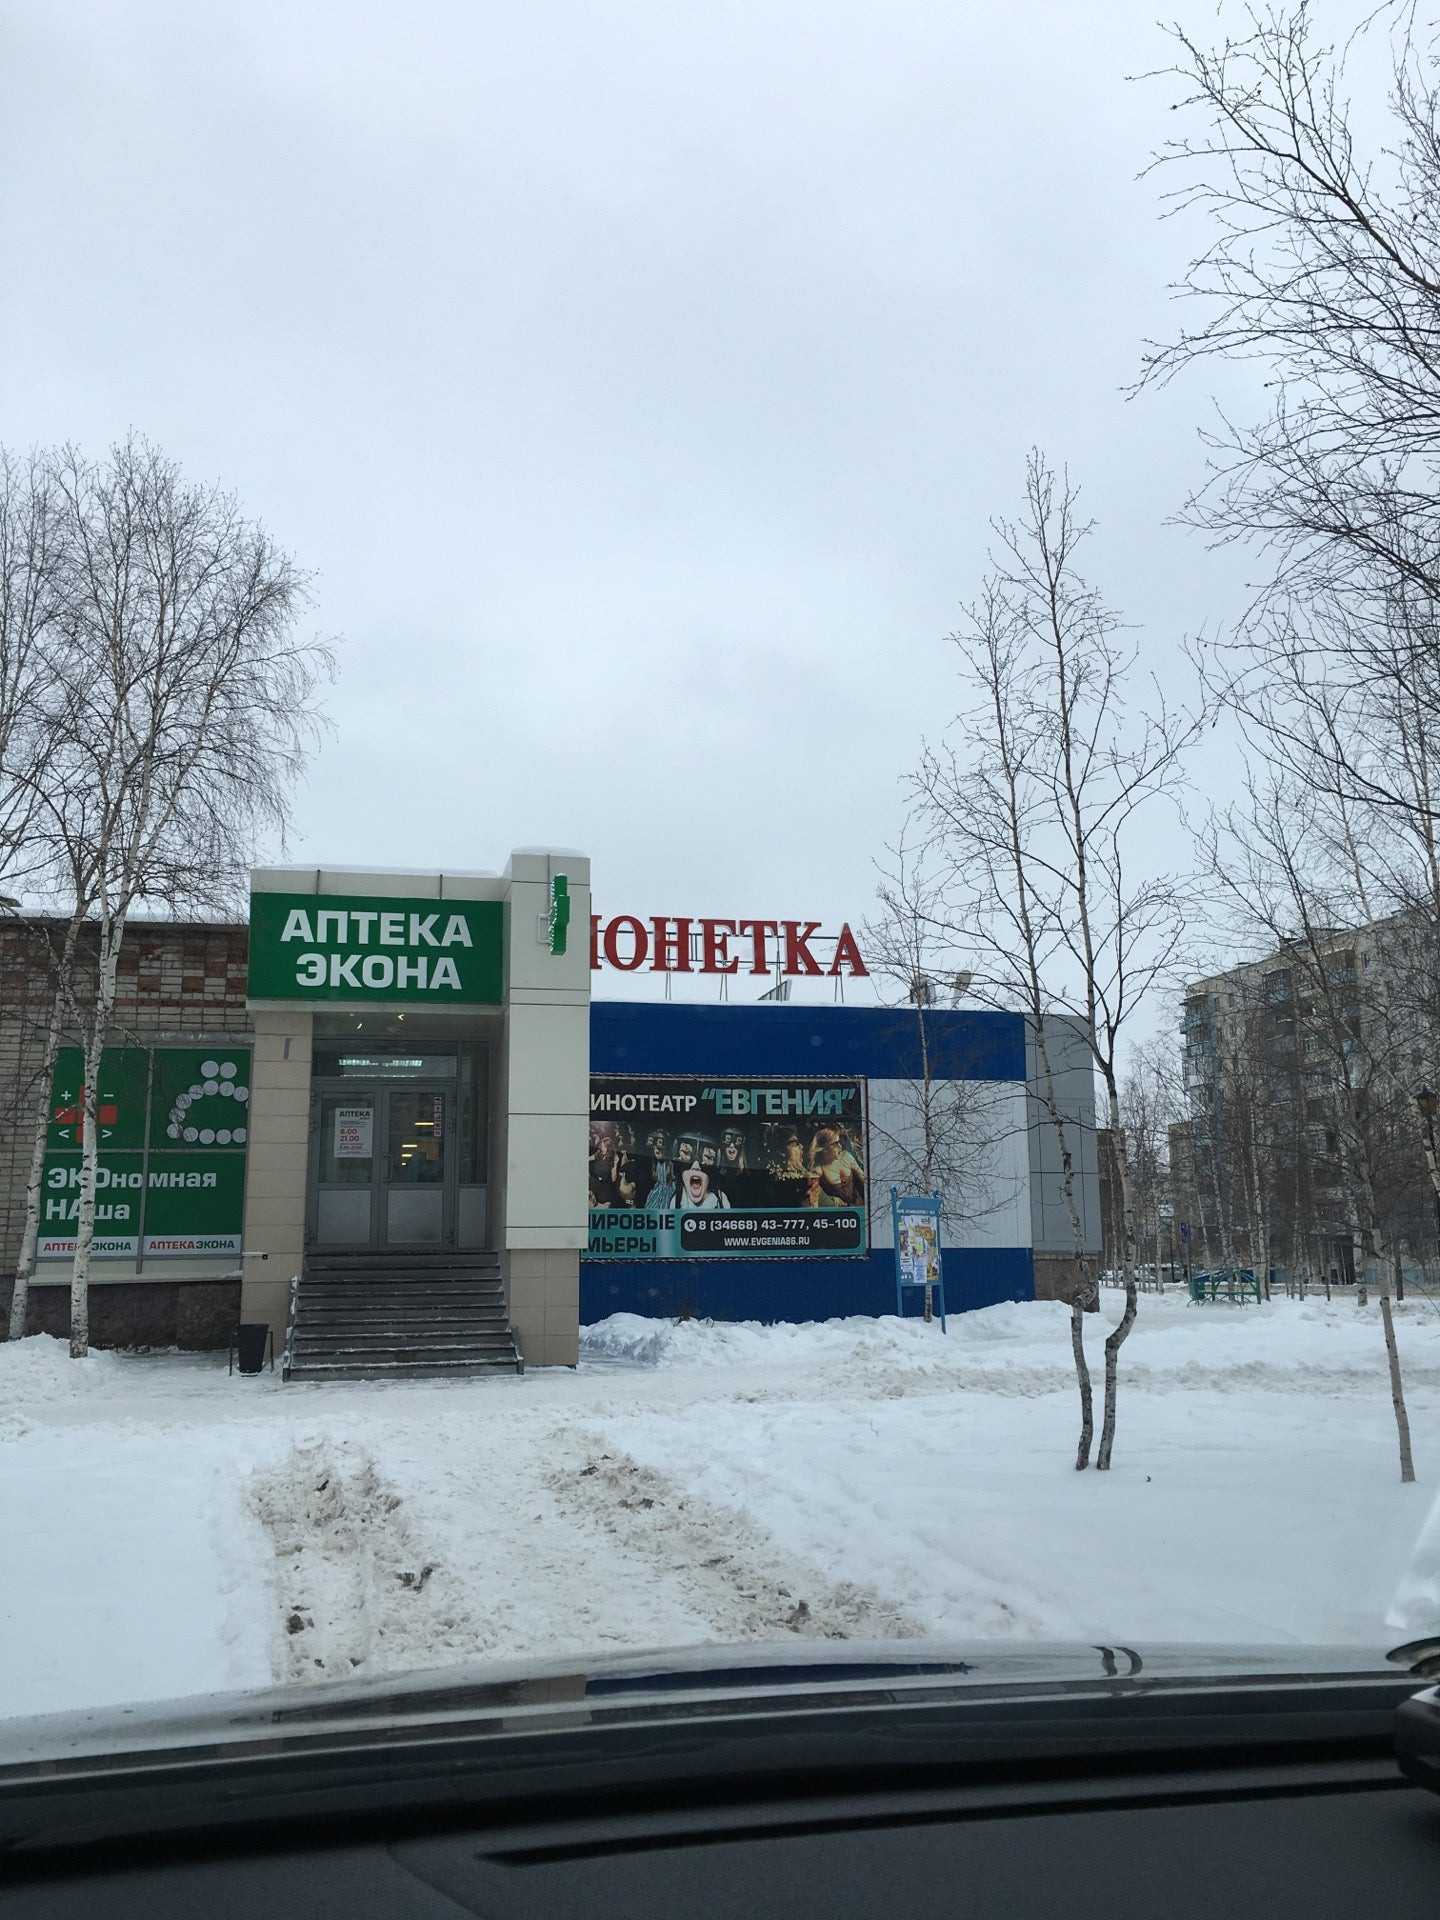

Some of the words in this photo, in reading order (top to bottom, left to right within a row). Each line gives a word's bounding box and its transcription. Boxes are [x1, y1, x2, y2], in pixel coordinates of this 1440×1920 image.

[280, 909, 474, 948] АПТЕКА
[295, 953, 463, 990] ЭКОНА
[590, 1093, 697, 1112] ИНОТЕАТР
[589, 1213, 675, 1231] ИРОВЫЕ
[699, 1221, 706, 1230] 8
[710, 1220, 757, 1231] (34668)
[813, 1218, 857, 1229] 45-100
[43, 1242, 80, 1252] АПТЕ
[91, 1241, 132, 1251] ЭКОНА
[582, 1236, 657, 1253] МЬЕРЫ
[724, 1236, 810, 1247] WWW.EVGENIA86.RU
